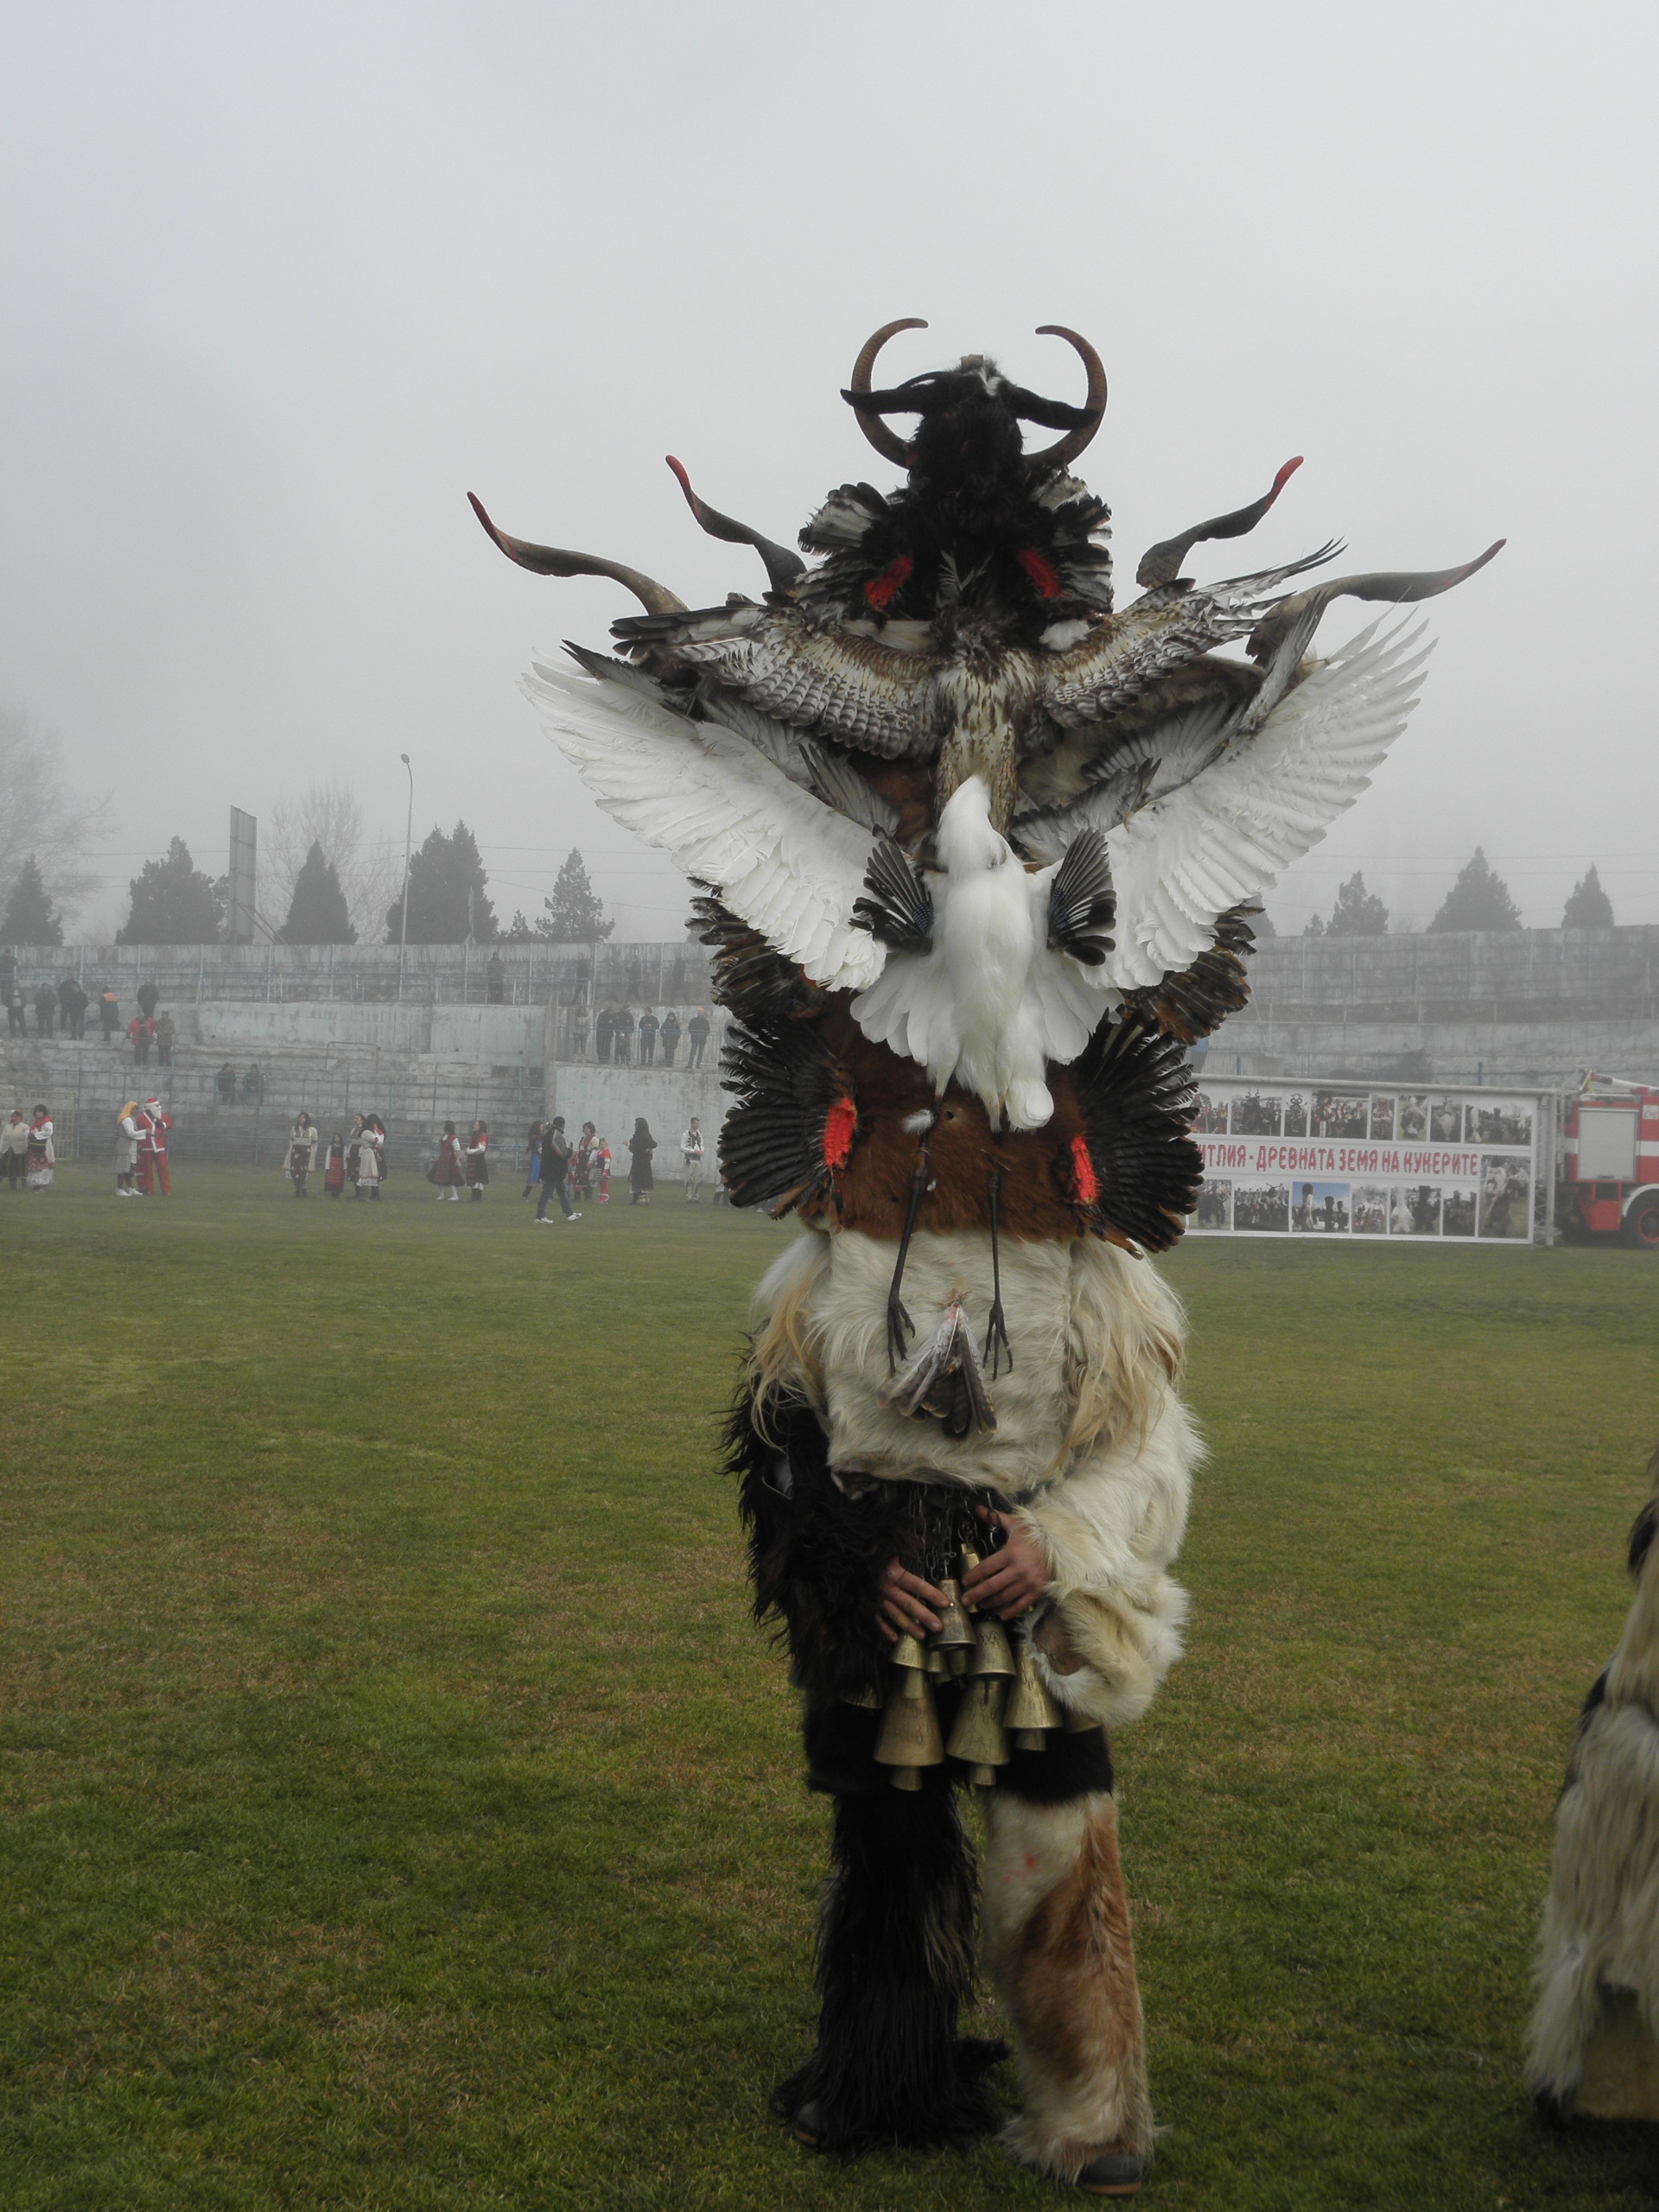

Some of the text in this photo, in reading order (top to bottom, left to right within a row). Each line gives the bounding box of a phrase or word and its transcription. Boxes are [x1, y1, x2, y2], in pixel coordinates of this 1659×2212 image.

[1256, 1145, 1335, 1172] ДРЕВНАТА
[1338, 1148, 1378, 1172] ЗЕМЯ
[1382, 1150, 1400, 1173] НА
[1403, 1151, 1478, 1176] КУКЕРИТЕ
